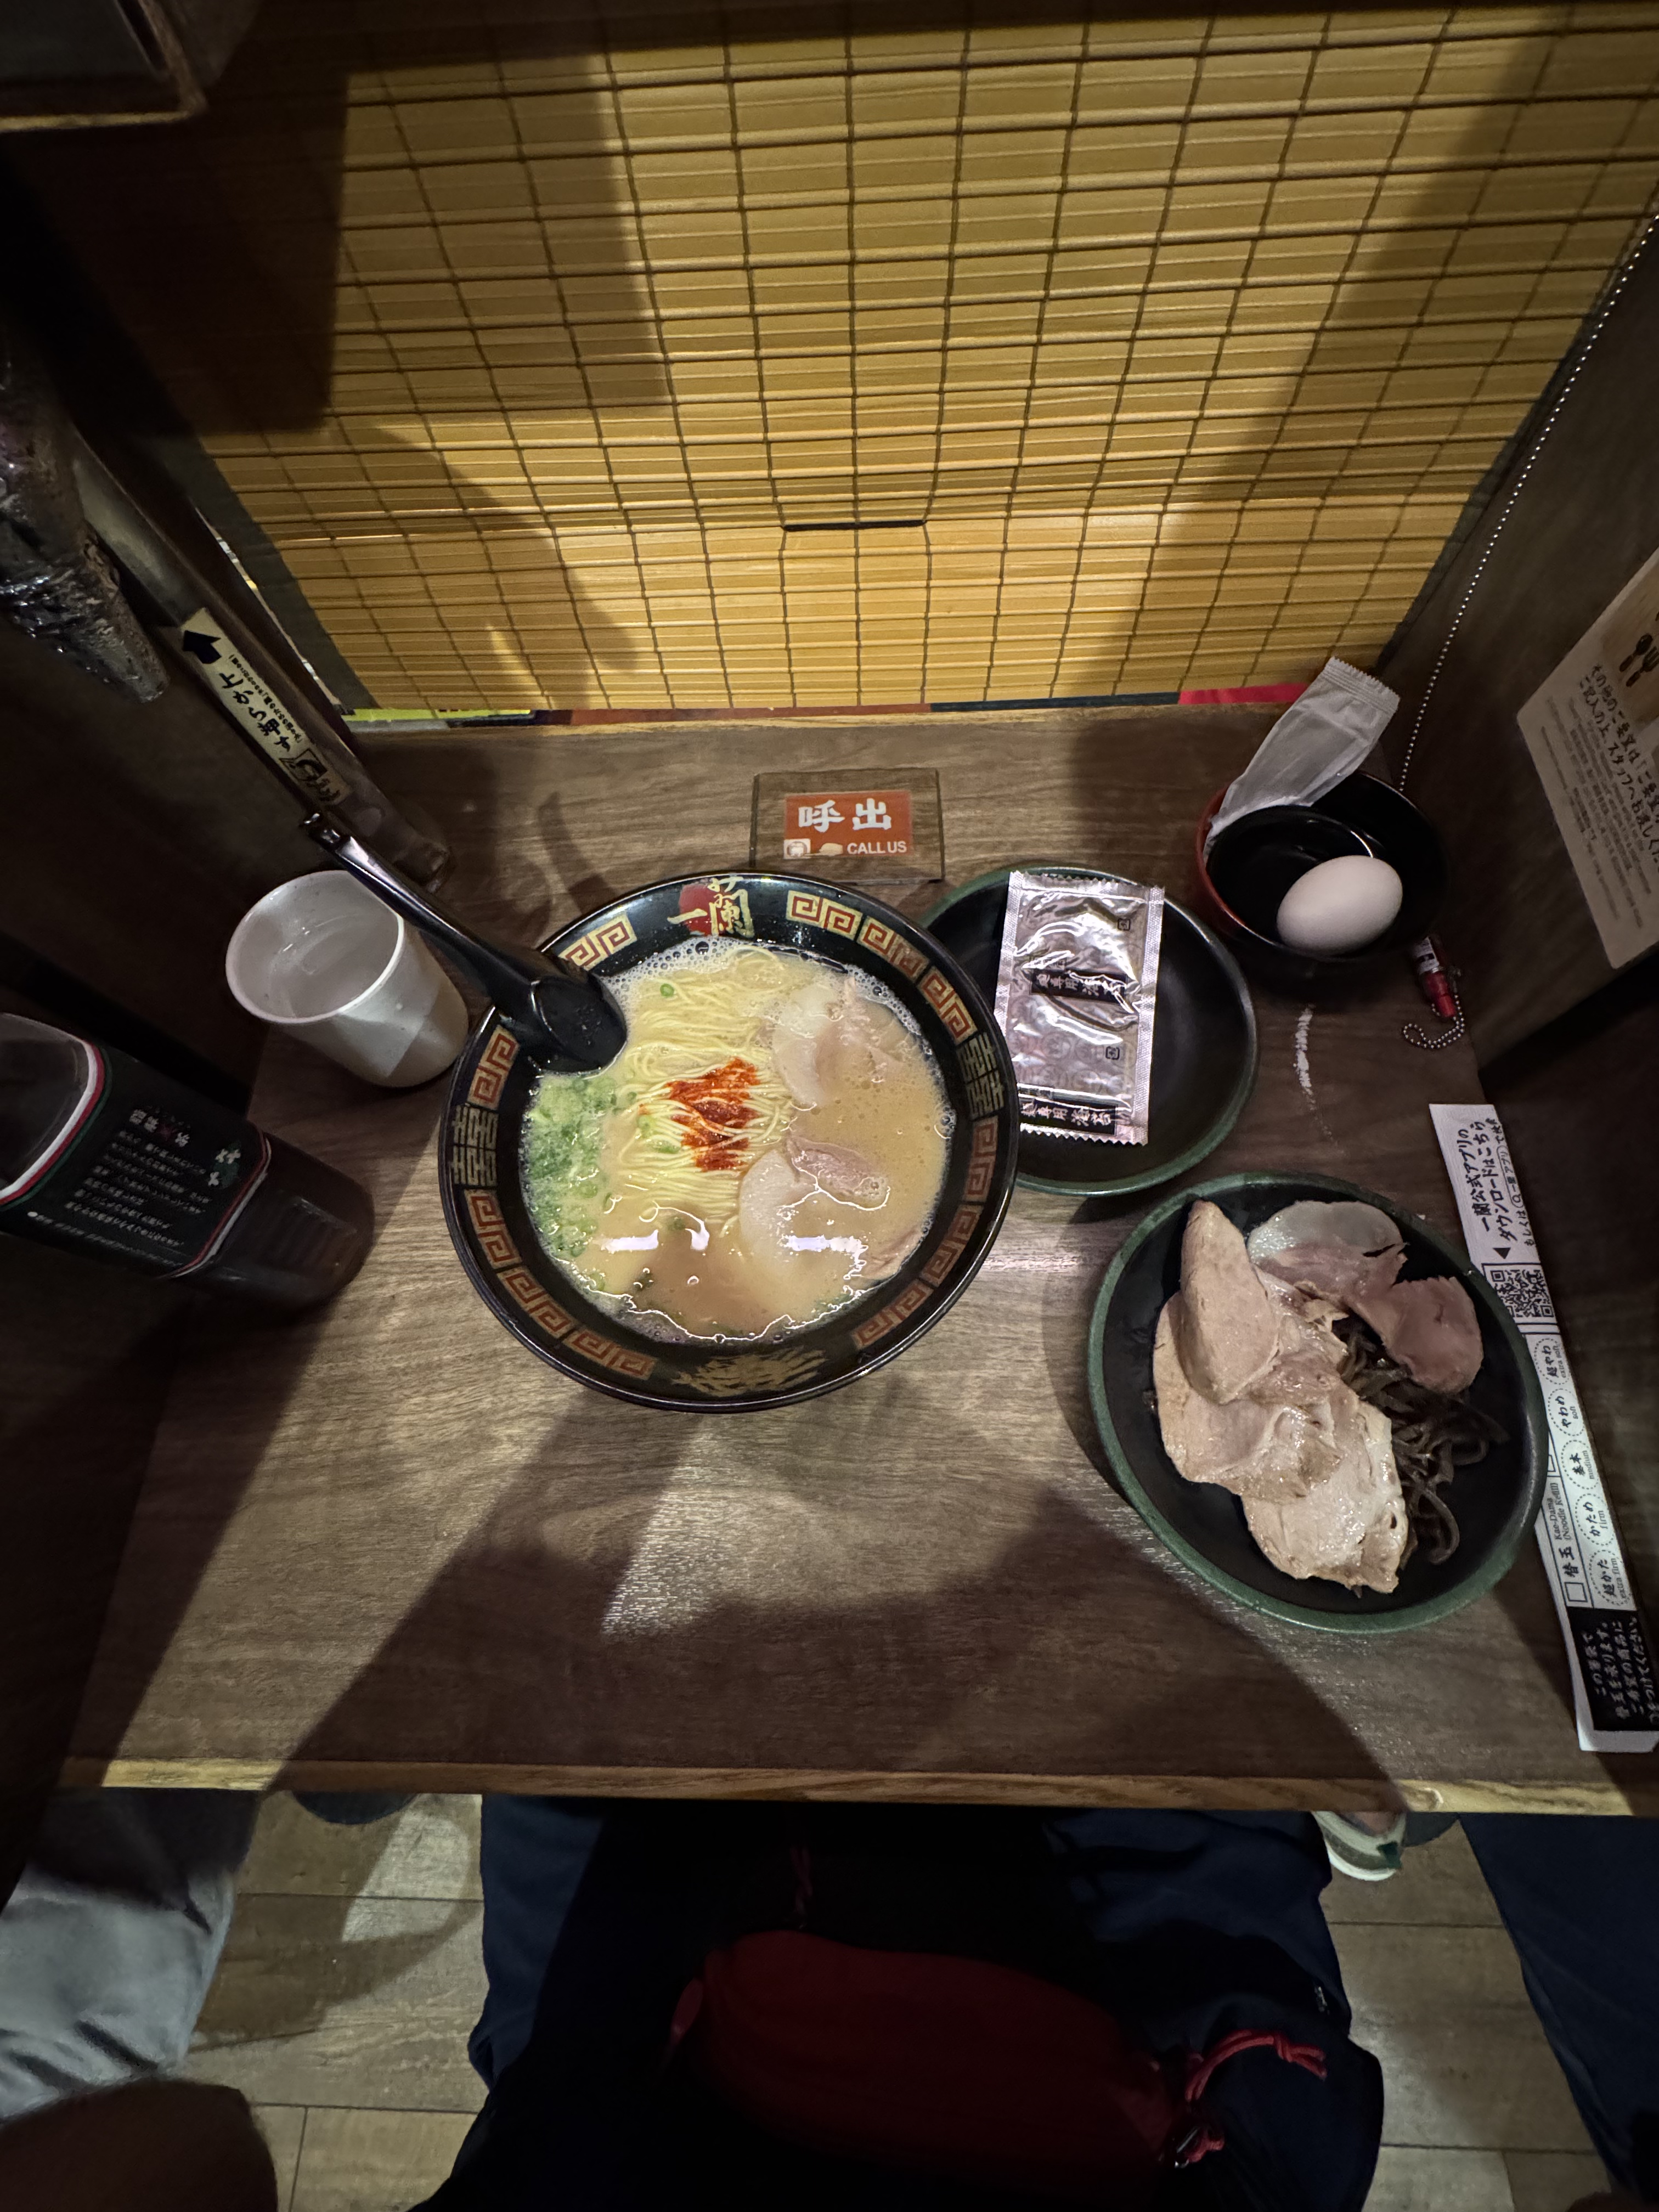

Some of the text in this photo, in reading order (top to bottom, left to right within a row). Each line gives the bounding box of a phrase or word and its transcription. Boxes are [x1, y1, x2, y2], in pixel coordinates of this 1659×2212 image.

[219, 673, 291, 752] 上から押す
[798, 798, 892, 833] 呼出
[847, 840, 907, 855] CALL US
[666, 876, 755, 938] 一蘭
[1457, 1128, 1492, 1232] 一蘭公式アプリの
[1470, 1121, 1518, 1242] ダウンロードはこちら
[1516, 1209, 1535, 1247] もしくは
[1541, 1345, 1560, 1379] 超やわ
[1552, 1345, 1566, 1379] extra soft
[1555, 1396, 1572, 1428] やわめ
[1570, 1406, 1578, 1420] soft
[1569, 1452, 1585, 1476] 基本
[1582, 1450, 1595, 1480] medium
[1547, 1497, 1562, 1541] Kae-Dama
[1557, 1508, 1572, 1541] (Noodle
[1583, 1502, 1604, 1537] かため
[1598, 1510, 1609, 1530] firm
[1558, 1546, 1579, 1578] 替玉
[1596, 1559, 1617, 1598] 超かた
[1610, 1558, 1627, 1599] extra firm
